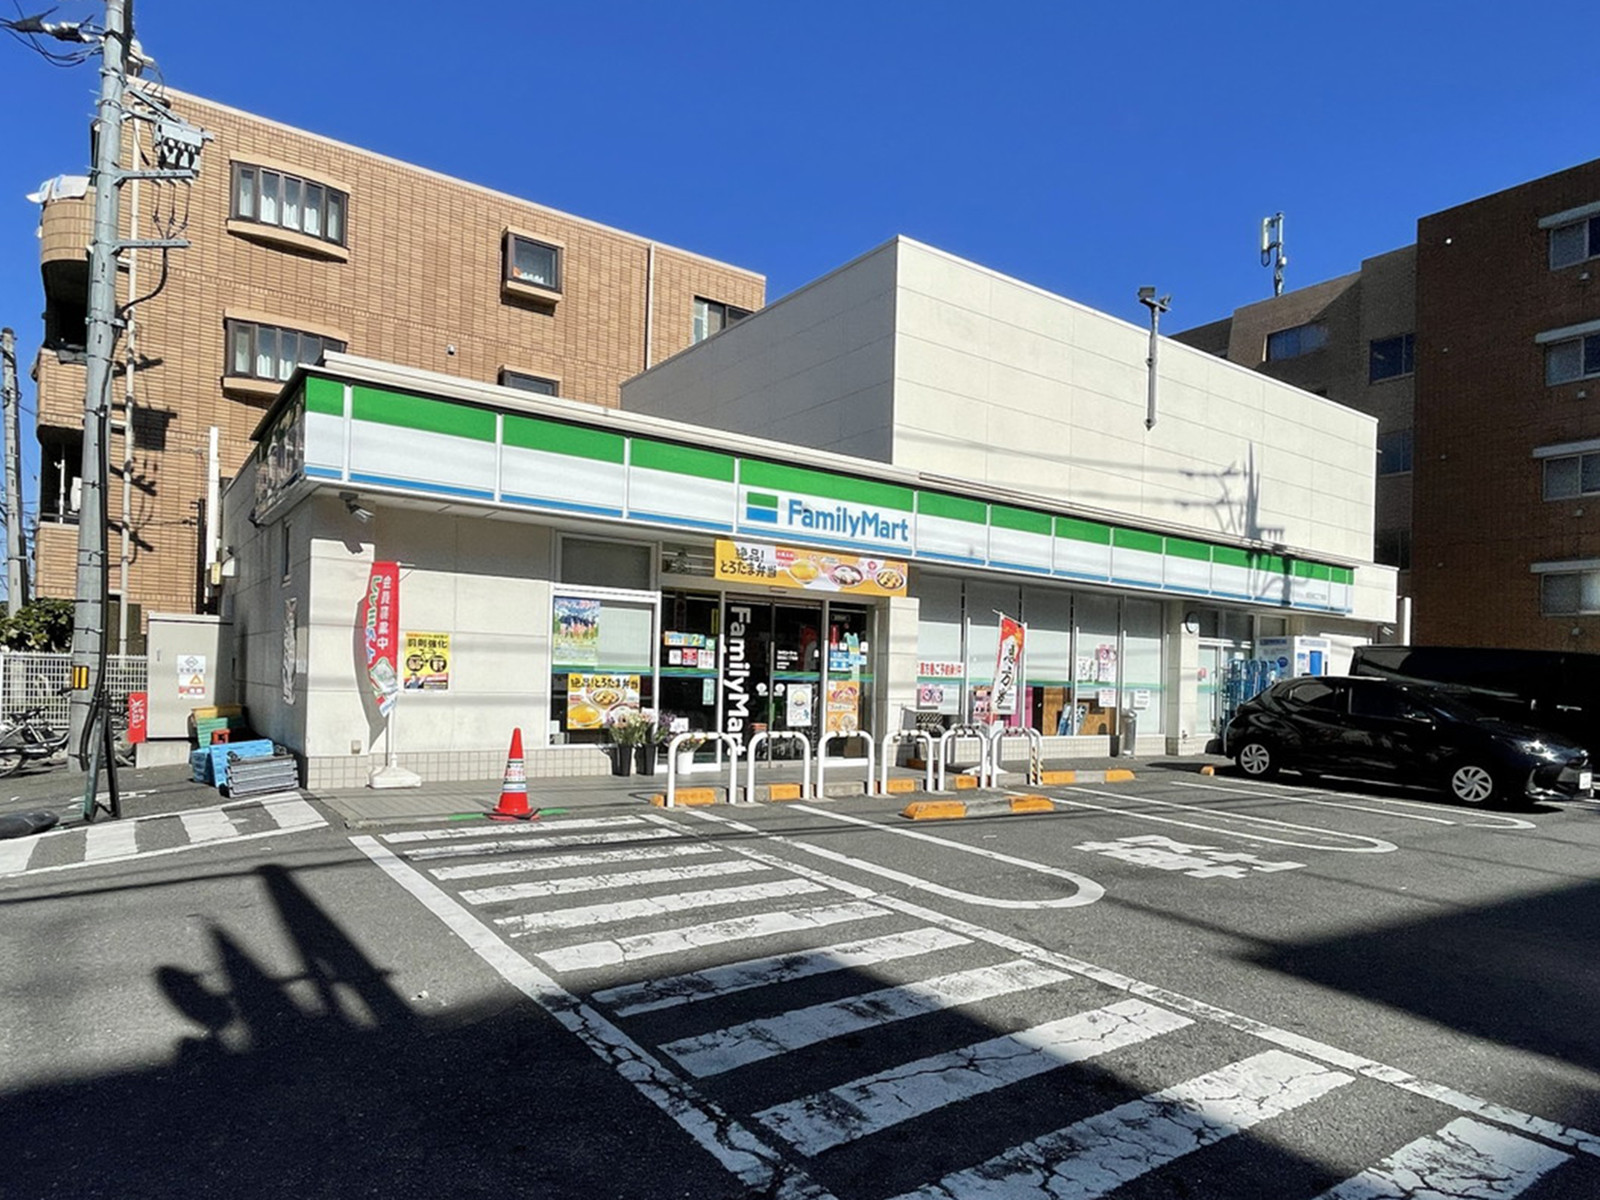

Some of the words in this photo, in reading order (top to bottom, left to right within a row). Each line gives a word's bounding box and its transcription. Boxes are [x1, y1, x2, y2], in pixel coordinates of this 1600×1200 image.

[788, 499, 909, 542] FamilyMart
[721, 559, 777, 578] とろたま弁当
